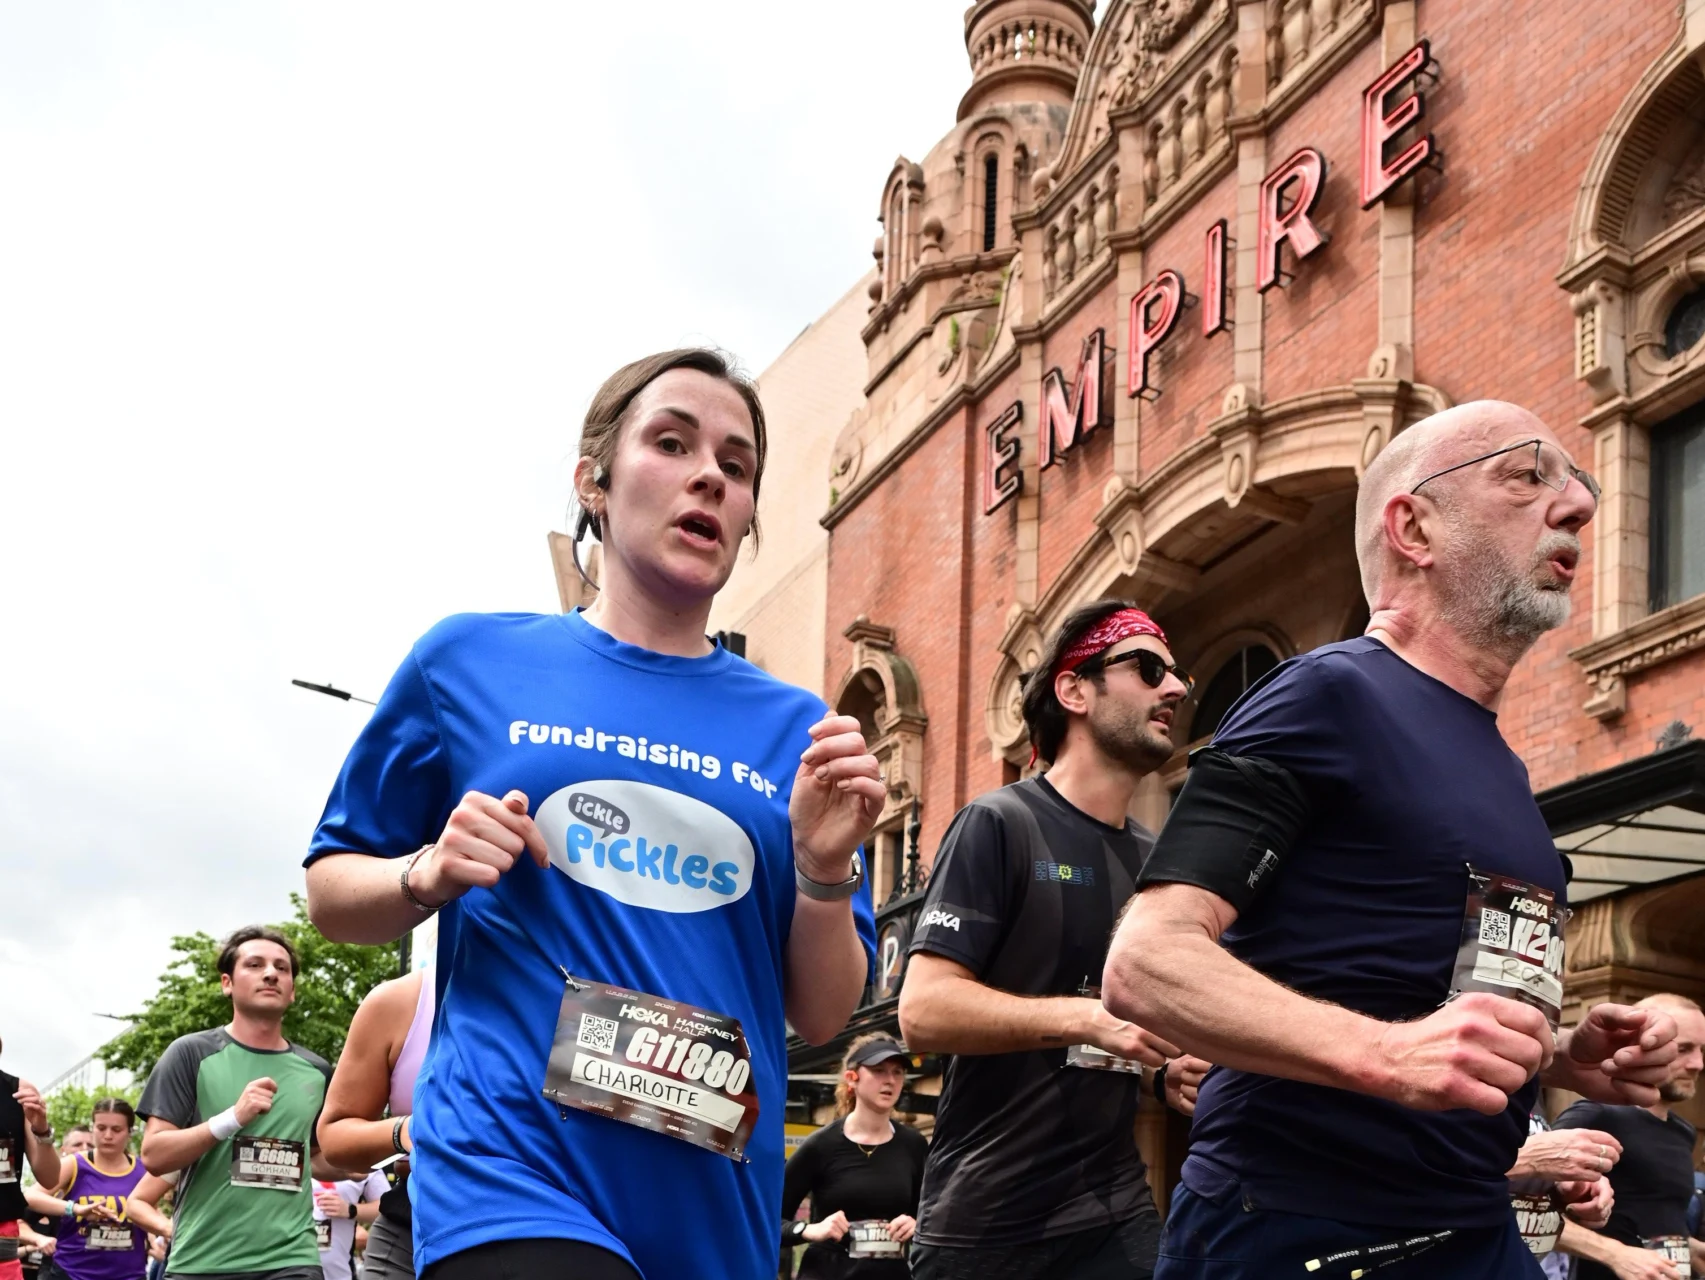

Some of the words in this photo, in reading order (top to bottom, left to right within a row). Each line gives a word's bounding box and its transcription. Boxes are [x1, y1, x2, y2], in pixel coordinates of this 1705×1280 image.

[985, 38, 1435, 515] EMPIRE
[509, 720, 721, 779] Fundraising
[732, 761, 777, 799] For
[575, 796, 624, 830] ickle
[566, 823, 740, 895] Pickles
[922, 910, 960, 932] HOKA
[1510, 896, 1548, 919] HOKA
[619, 1004, 669, 1028] HOKA
[675, 1017, 739, 1042] HACKNEY
[673, 1023, 706, 1037] HALF
[625, 1027, 750, 1096] G11880
[583, 1060, 699, 1107] CHARLOTTE
